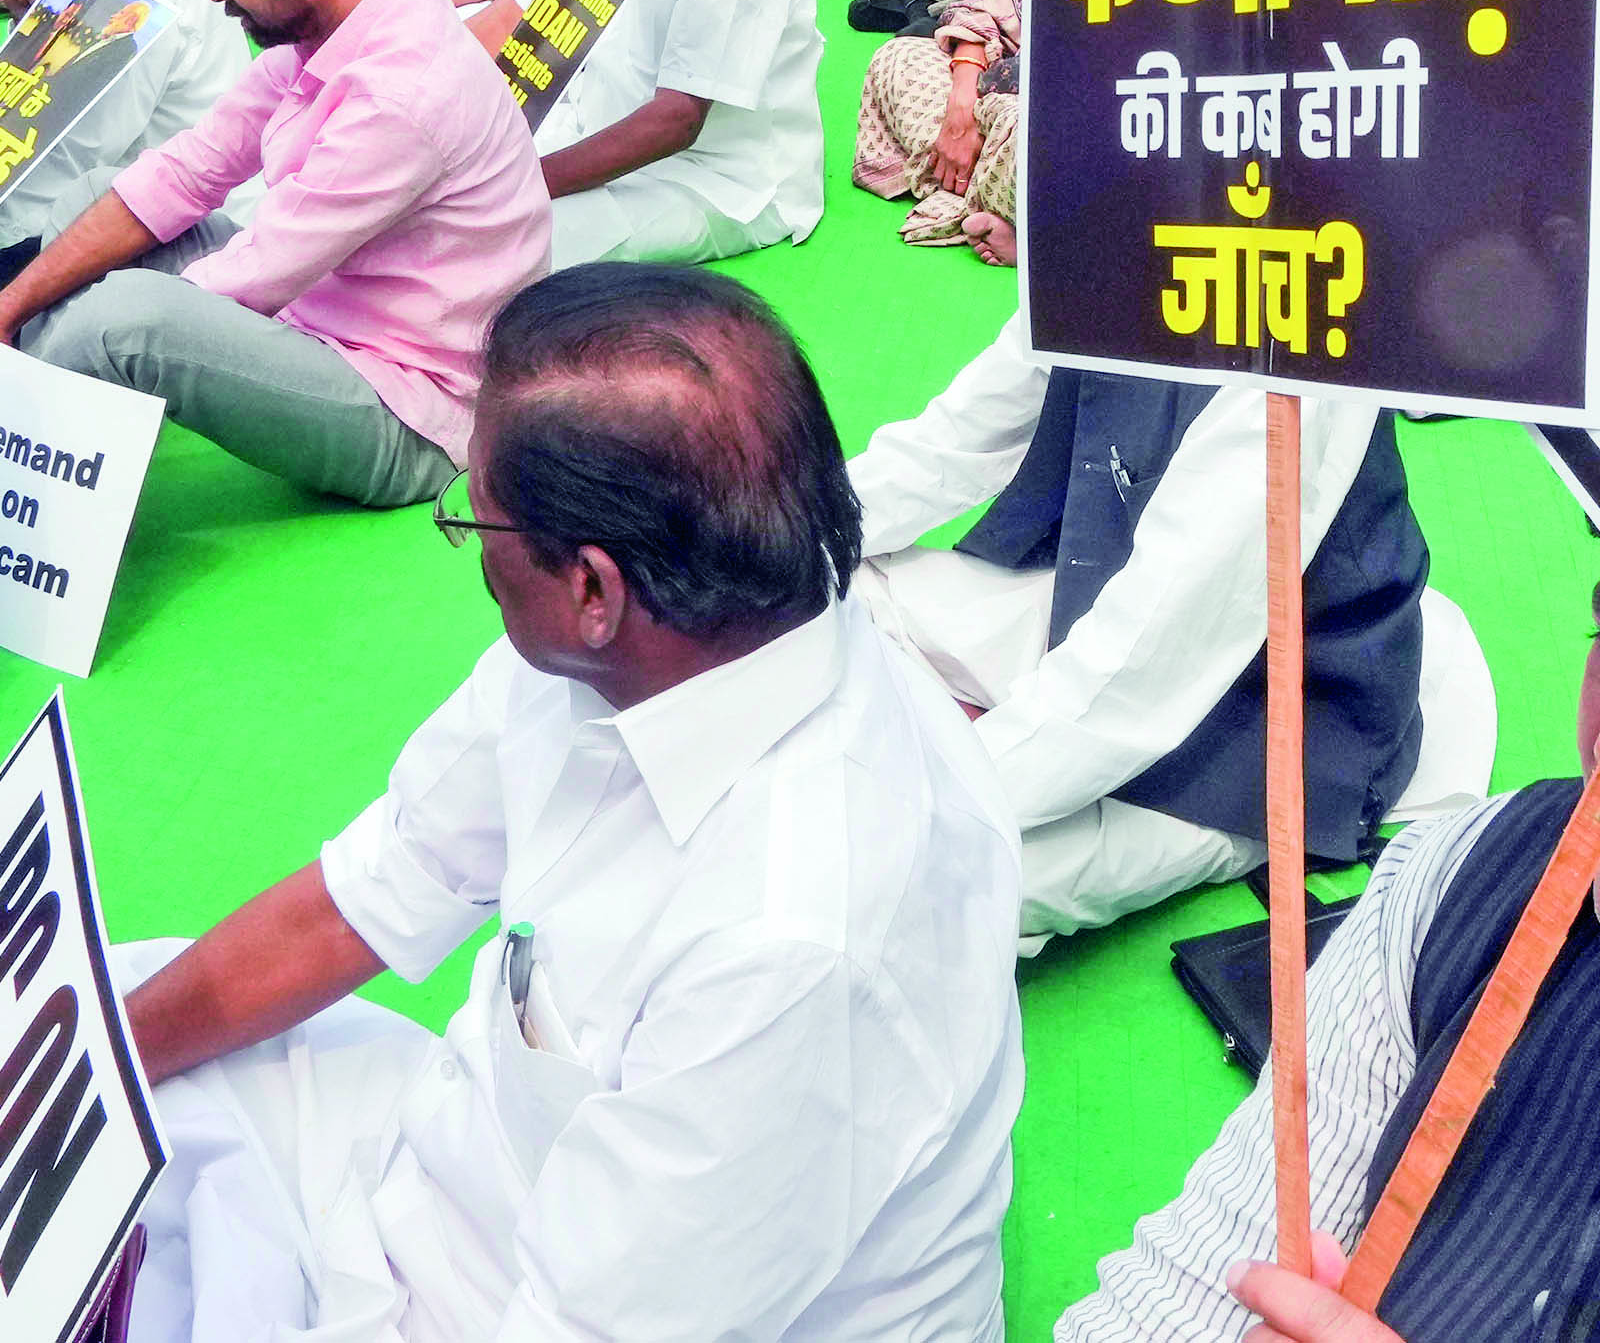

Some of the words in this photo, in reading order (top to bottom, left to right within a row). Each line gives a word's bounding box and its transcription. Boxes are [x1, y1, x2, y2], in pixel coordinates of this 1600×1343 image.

[1116, 50, 1190, 160] की
[1195, 69, 1288, 160] कब
[1291, 38, 1430, 160] होगी
[1, 489, 39, 529] on
